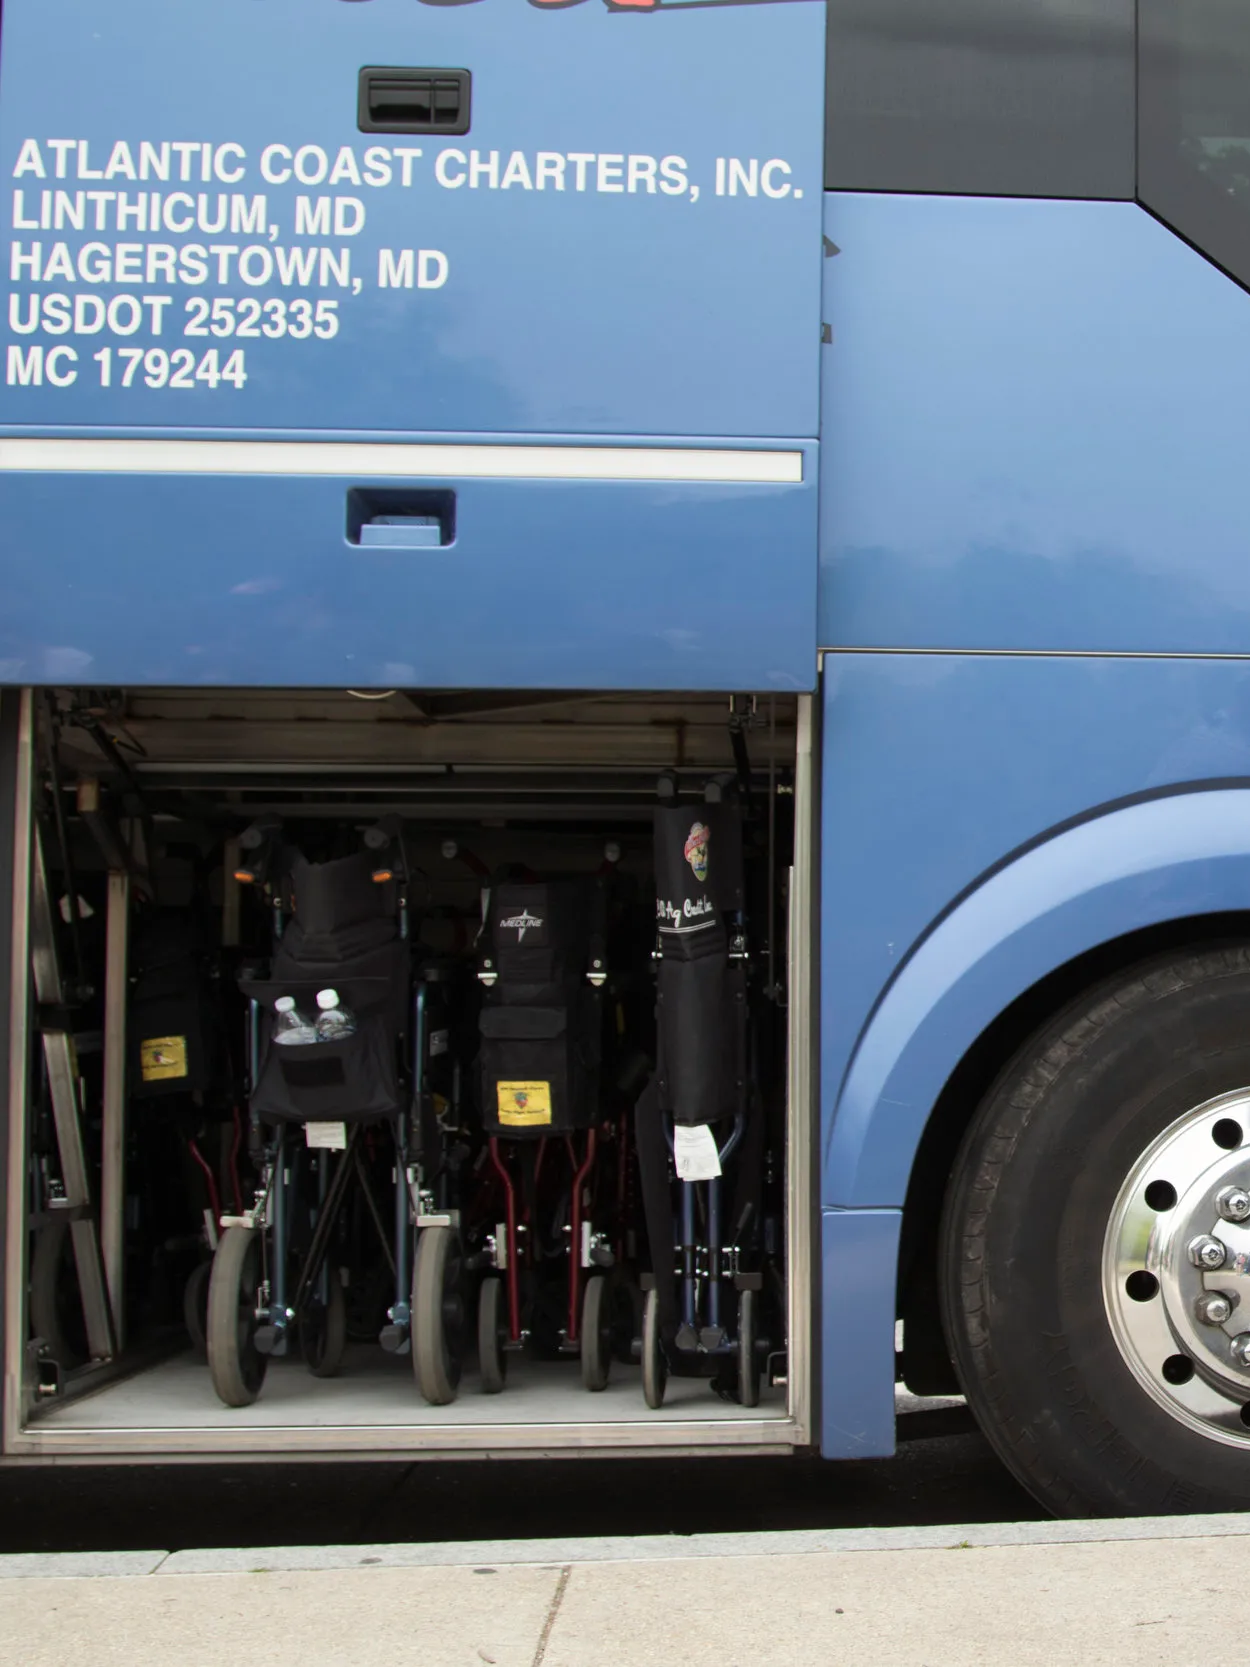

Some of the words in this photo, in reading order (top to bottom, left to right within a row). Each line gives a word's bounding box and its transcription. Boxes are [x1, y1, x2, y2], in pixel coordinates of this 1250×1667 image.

[12, 138, 247, 183] ATLANTIC
[260, 143, 423, 188] COAST
[435, 148, 700, 203] CHARTERS,
[715, 157, 804, 200] INC.
[12, 189, 280, 242] LINTHICUM,
[294, 195, 366, 237] MD
[10, 240, 363, 296] HAGERSTOWN,
[378, 248, 449, 289] MD
[9, 293, 173, 336] USDOT
[184, 297, 340, 339] 252335
[6, 345, 78, 387] MC
[94, 347, 248, 389] 179244
[500, 919, 543, 927] MEDLINE
